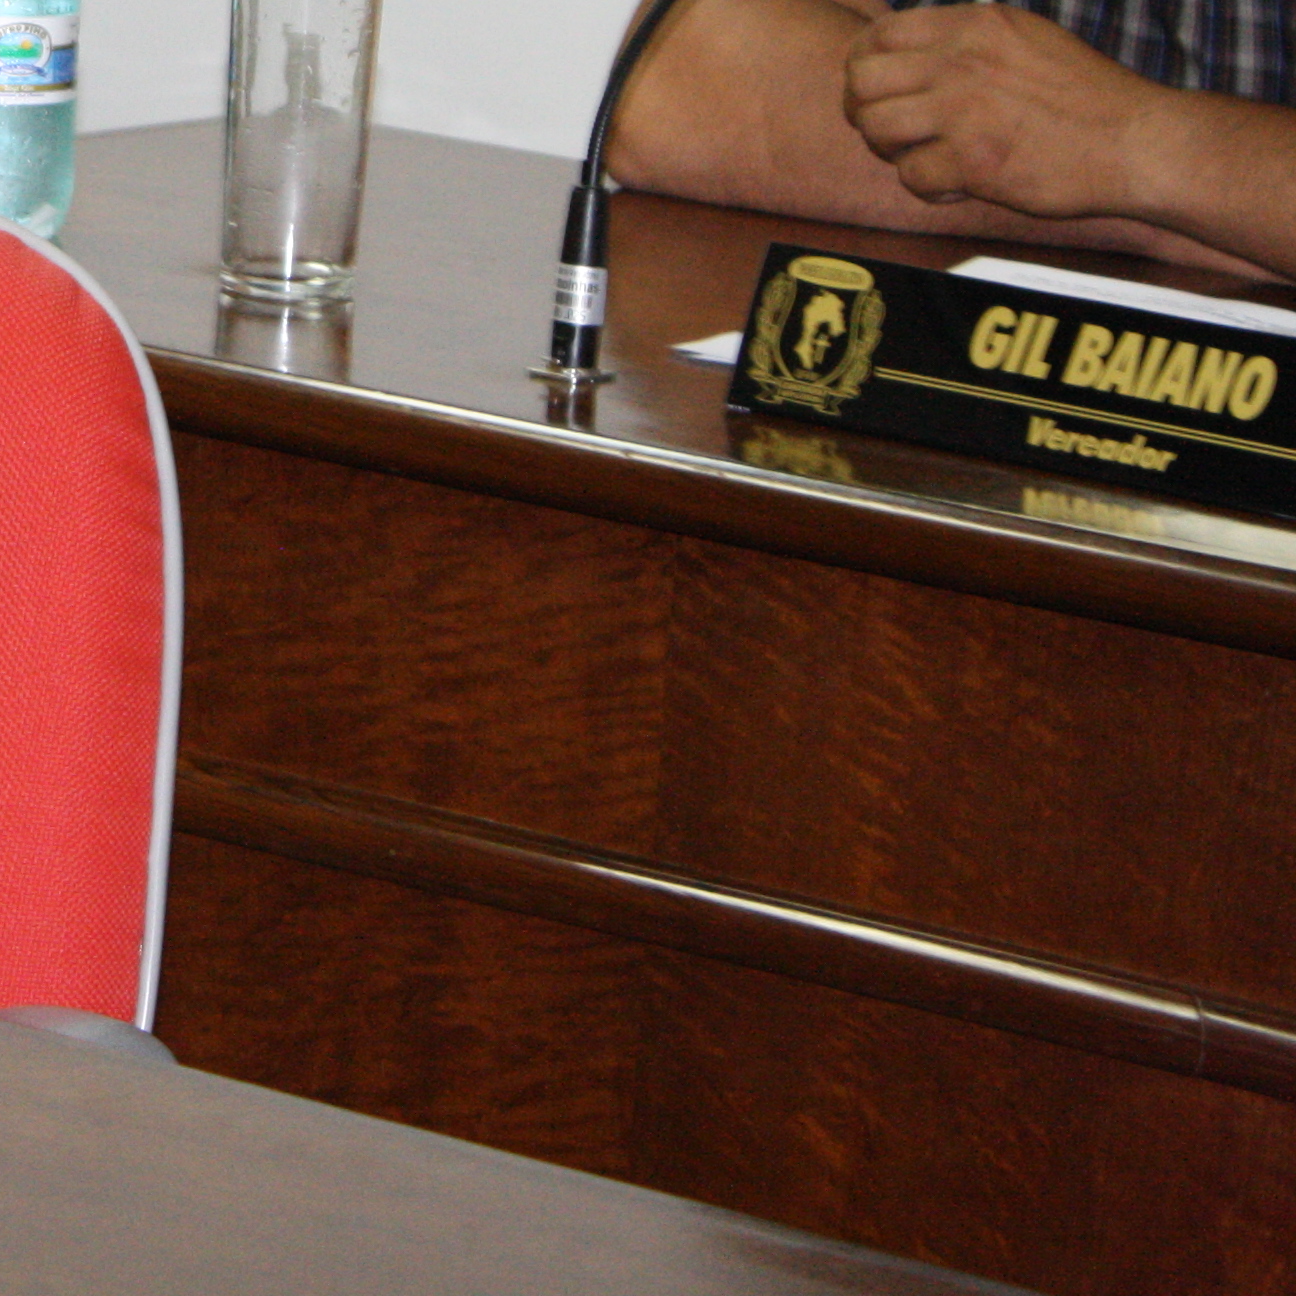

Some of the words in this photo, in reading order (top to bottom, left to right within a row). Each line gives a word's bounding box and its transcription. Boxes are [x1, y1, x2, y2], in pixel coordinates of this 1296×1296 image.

[968, 304, 1060, 380] GIL
[1061, 322, 1278, 422] BAIANO
[1026, 415, 1178, 472] Vereador
